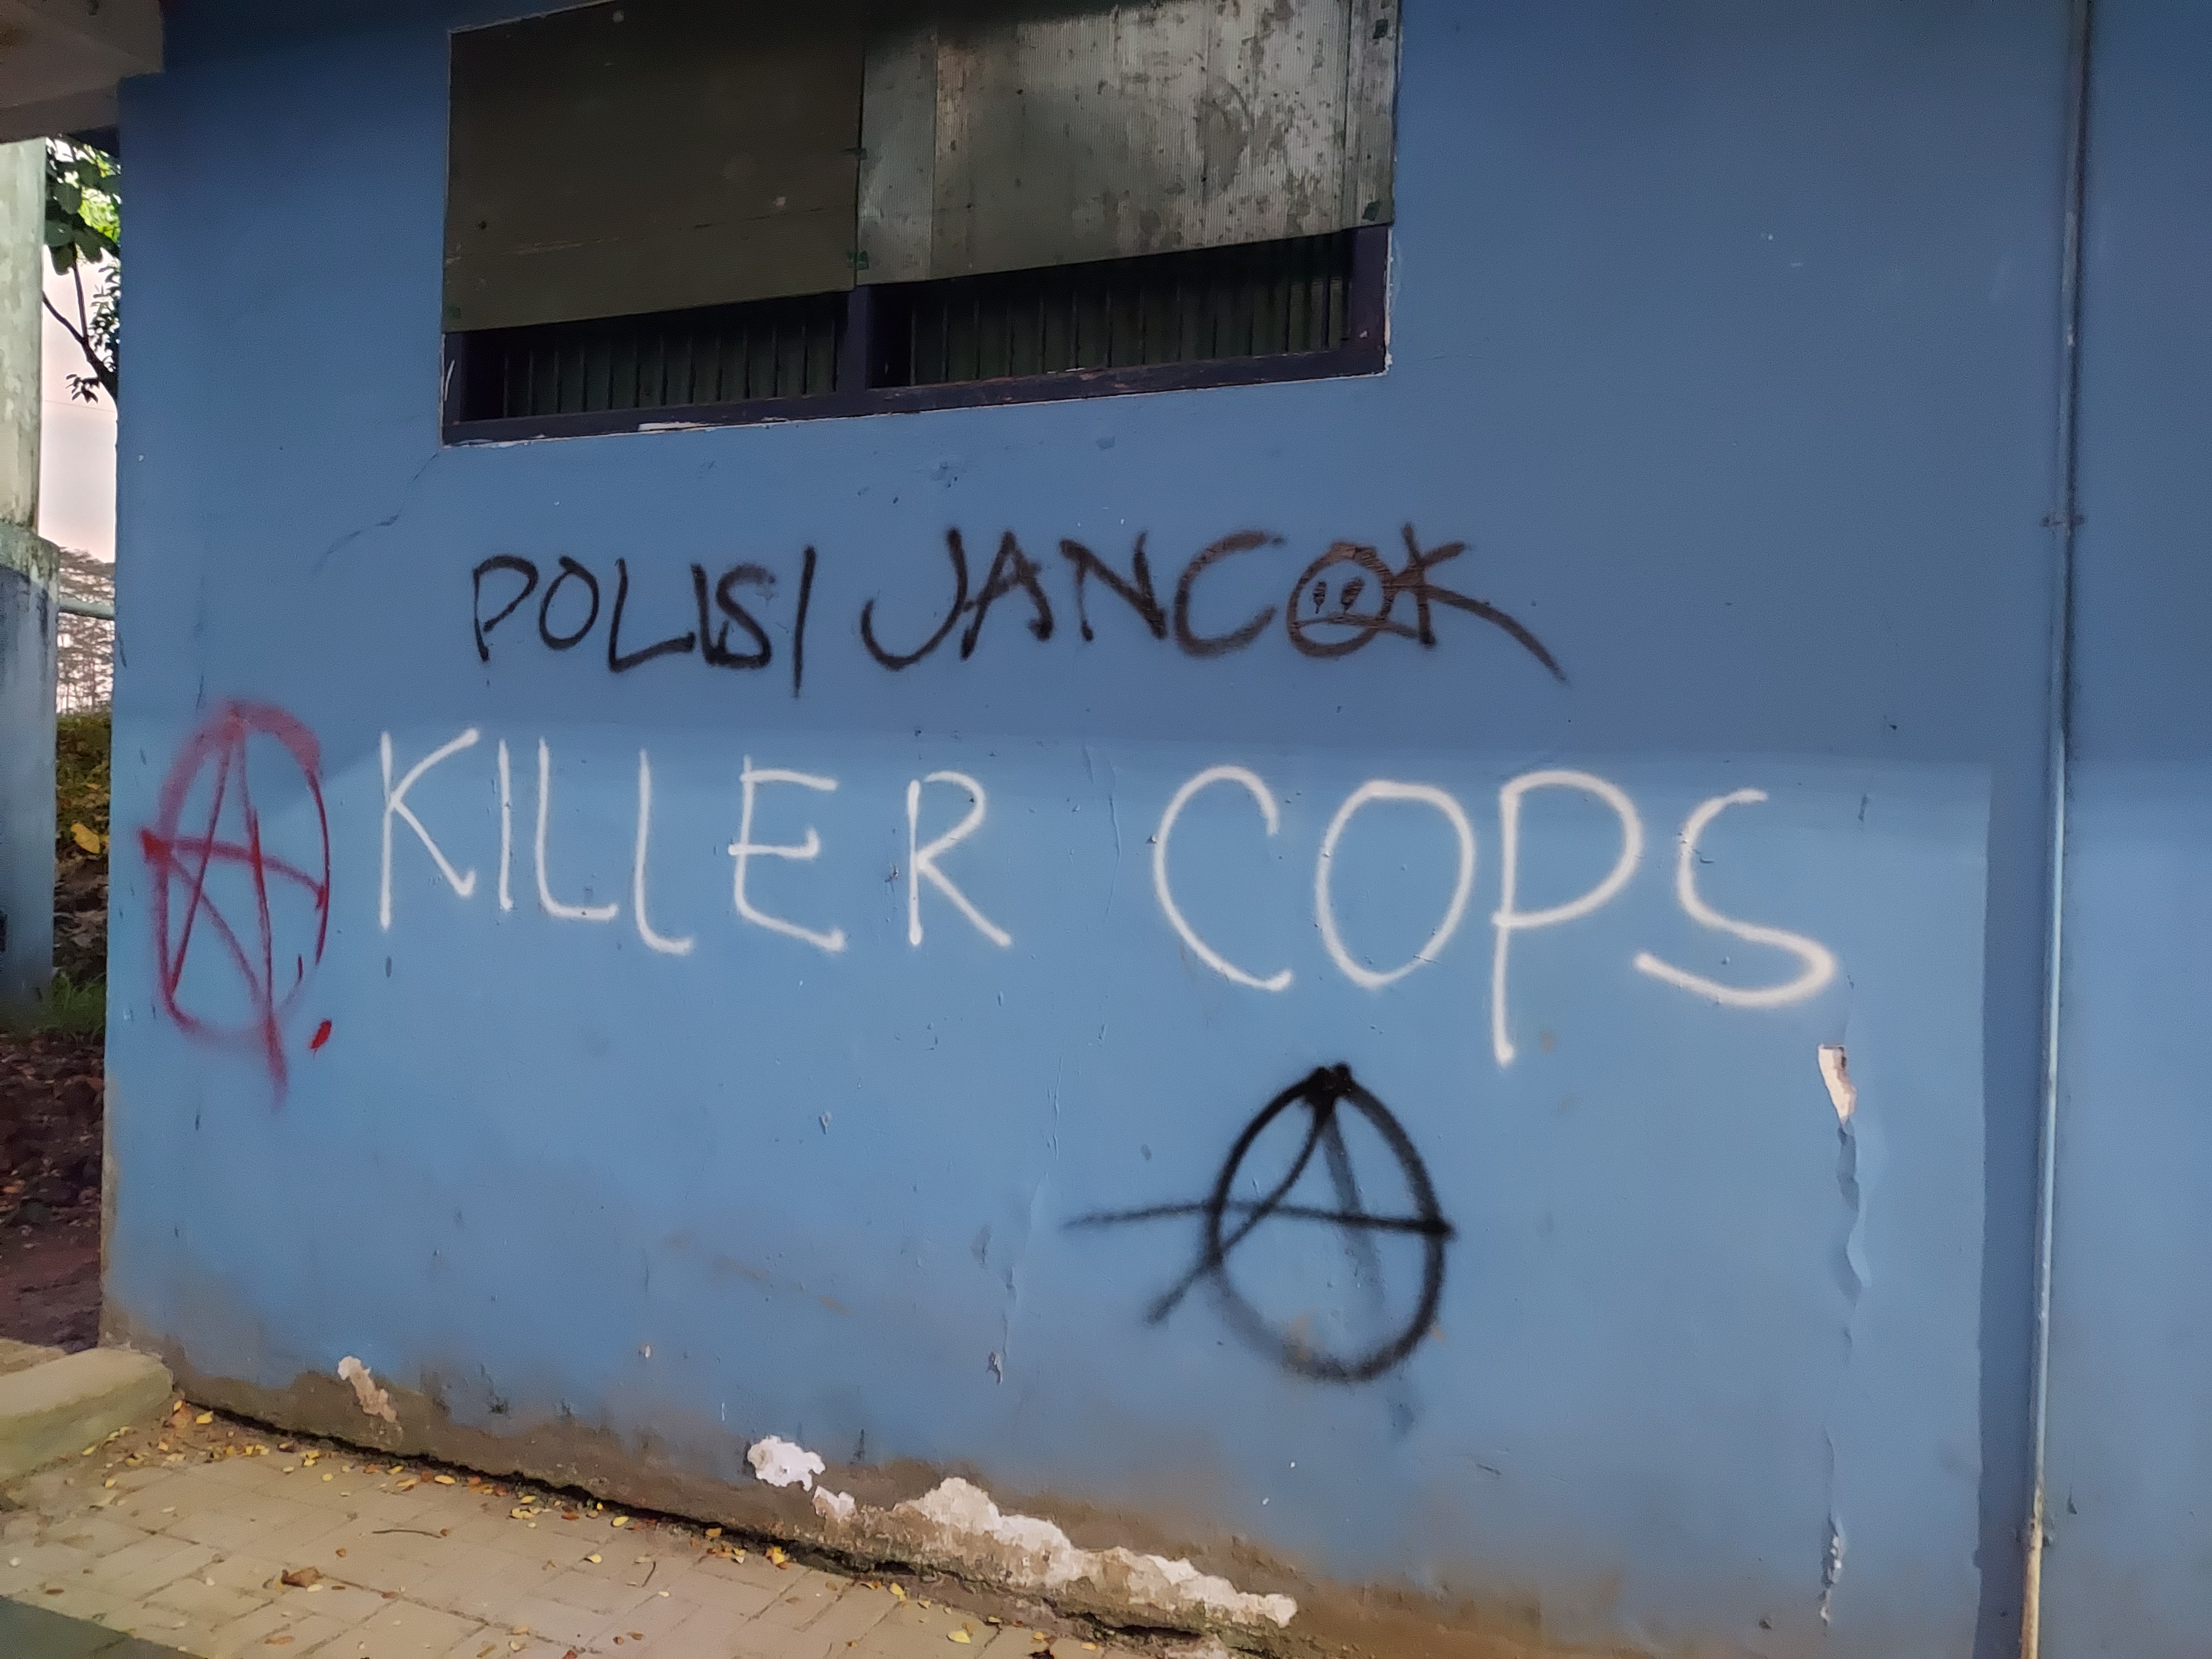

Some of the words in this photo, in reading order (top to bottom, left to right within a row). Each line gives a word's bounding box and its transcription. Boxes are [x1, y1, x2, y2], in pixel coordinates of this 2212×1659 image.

[471, 545, 816, 698] POLISI
[860, 523, 1568, 685] JANCOK
[376, 726, 1013, 956] KILLER
[1150, 764, 1838, 1067] COPS
